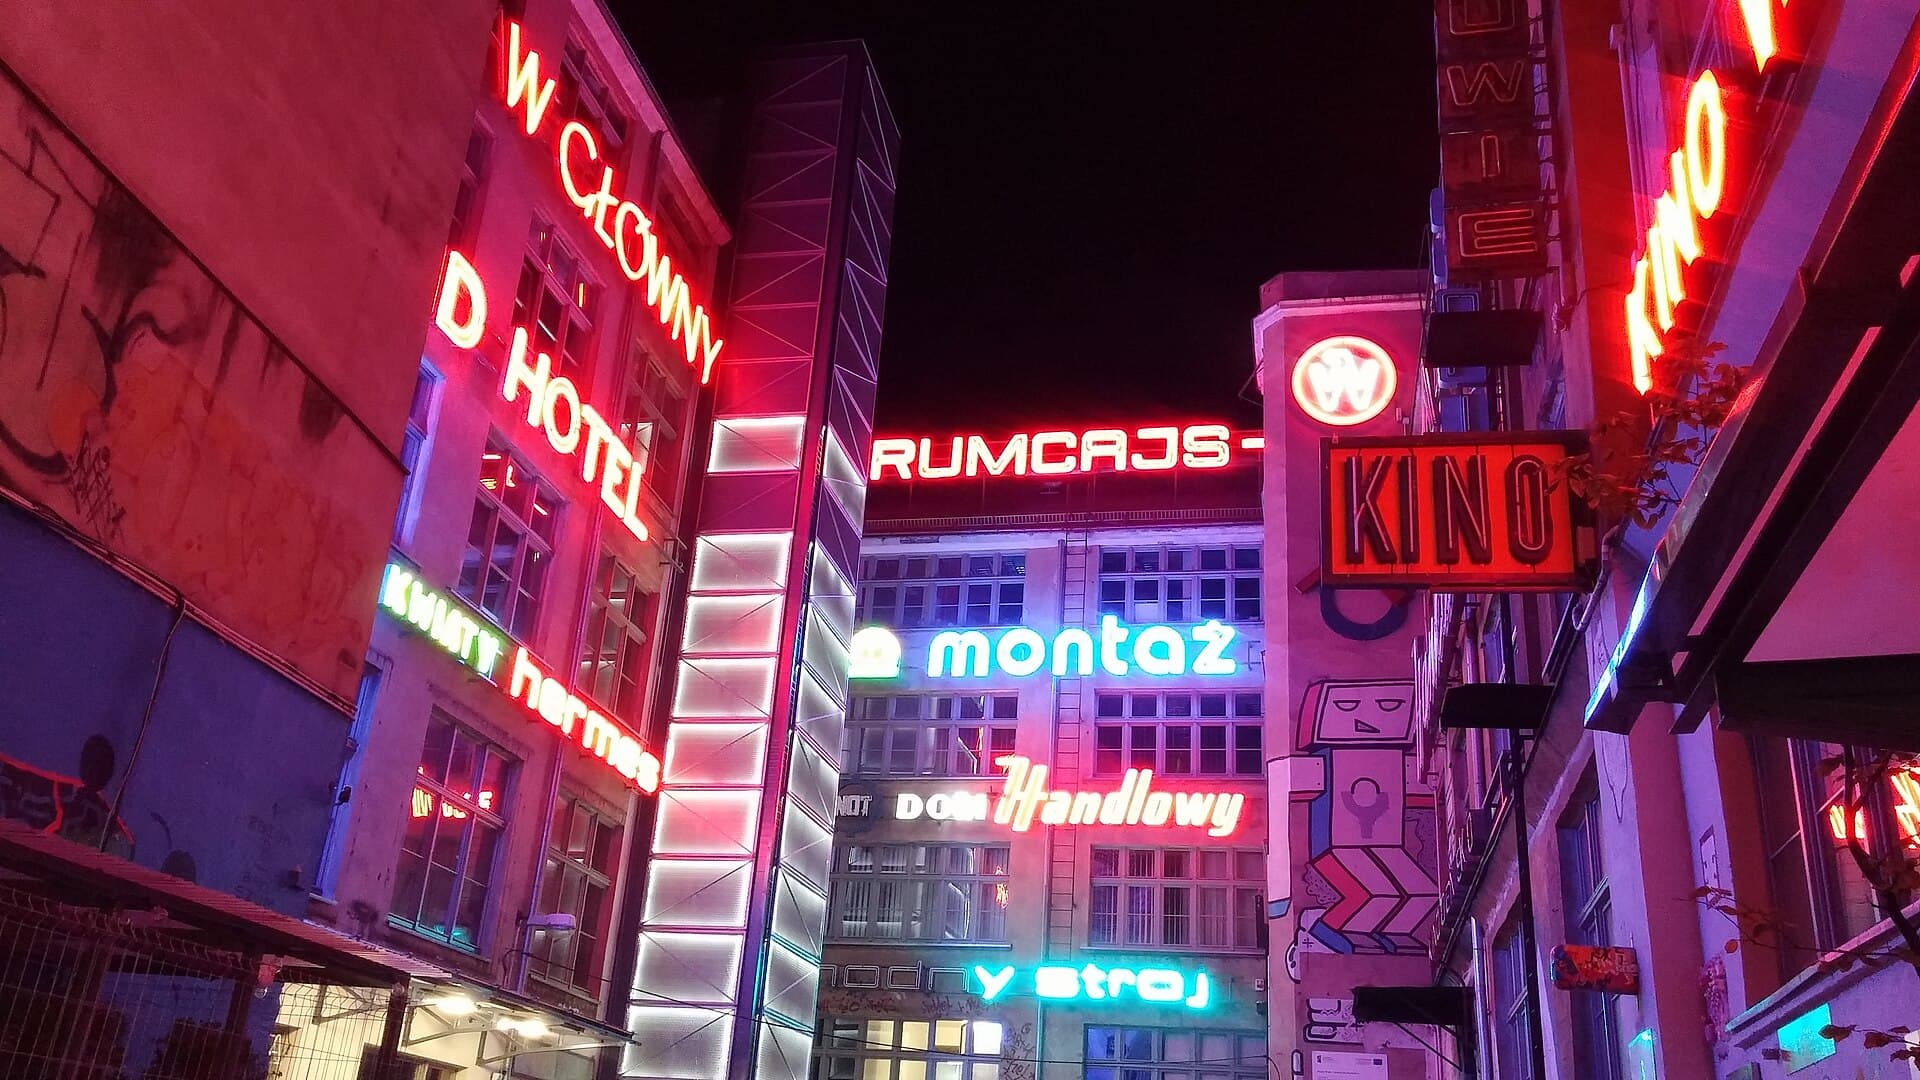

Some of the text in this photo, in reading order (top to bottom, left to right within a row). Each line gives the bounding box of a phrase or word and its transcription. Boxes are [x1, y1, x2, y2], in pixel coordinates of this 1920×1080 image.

[502, 327, 649, 542] HOTEL
[870, 424, 1231, 481] RUMCAJS
[1345, 454, 1554, 566] KINO
[927, 613, 1237, 678] montaż
[509, 645, 663, 794] hermes
[895, 755, 1245, 837] DOM Handlowy
